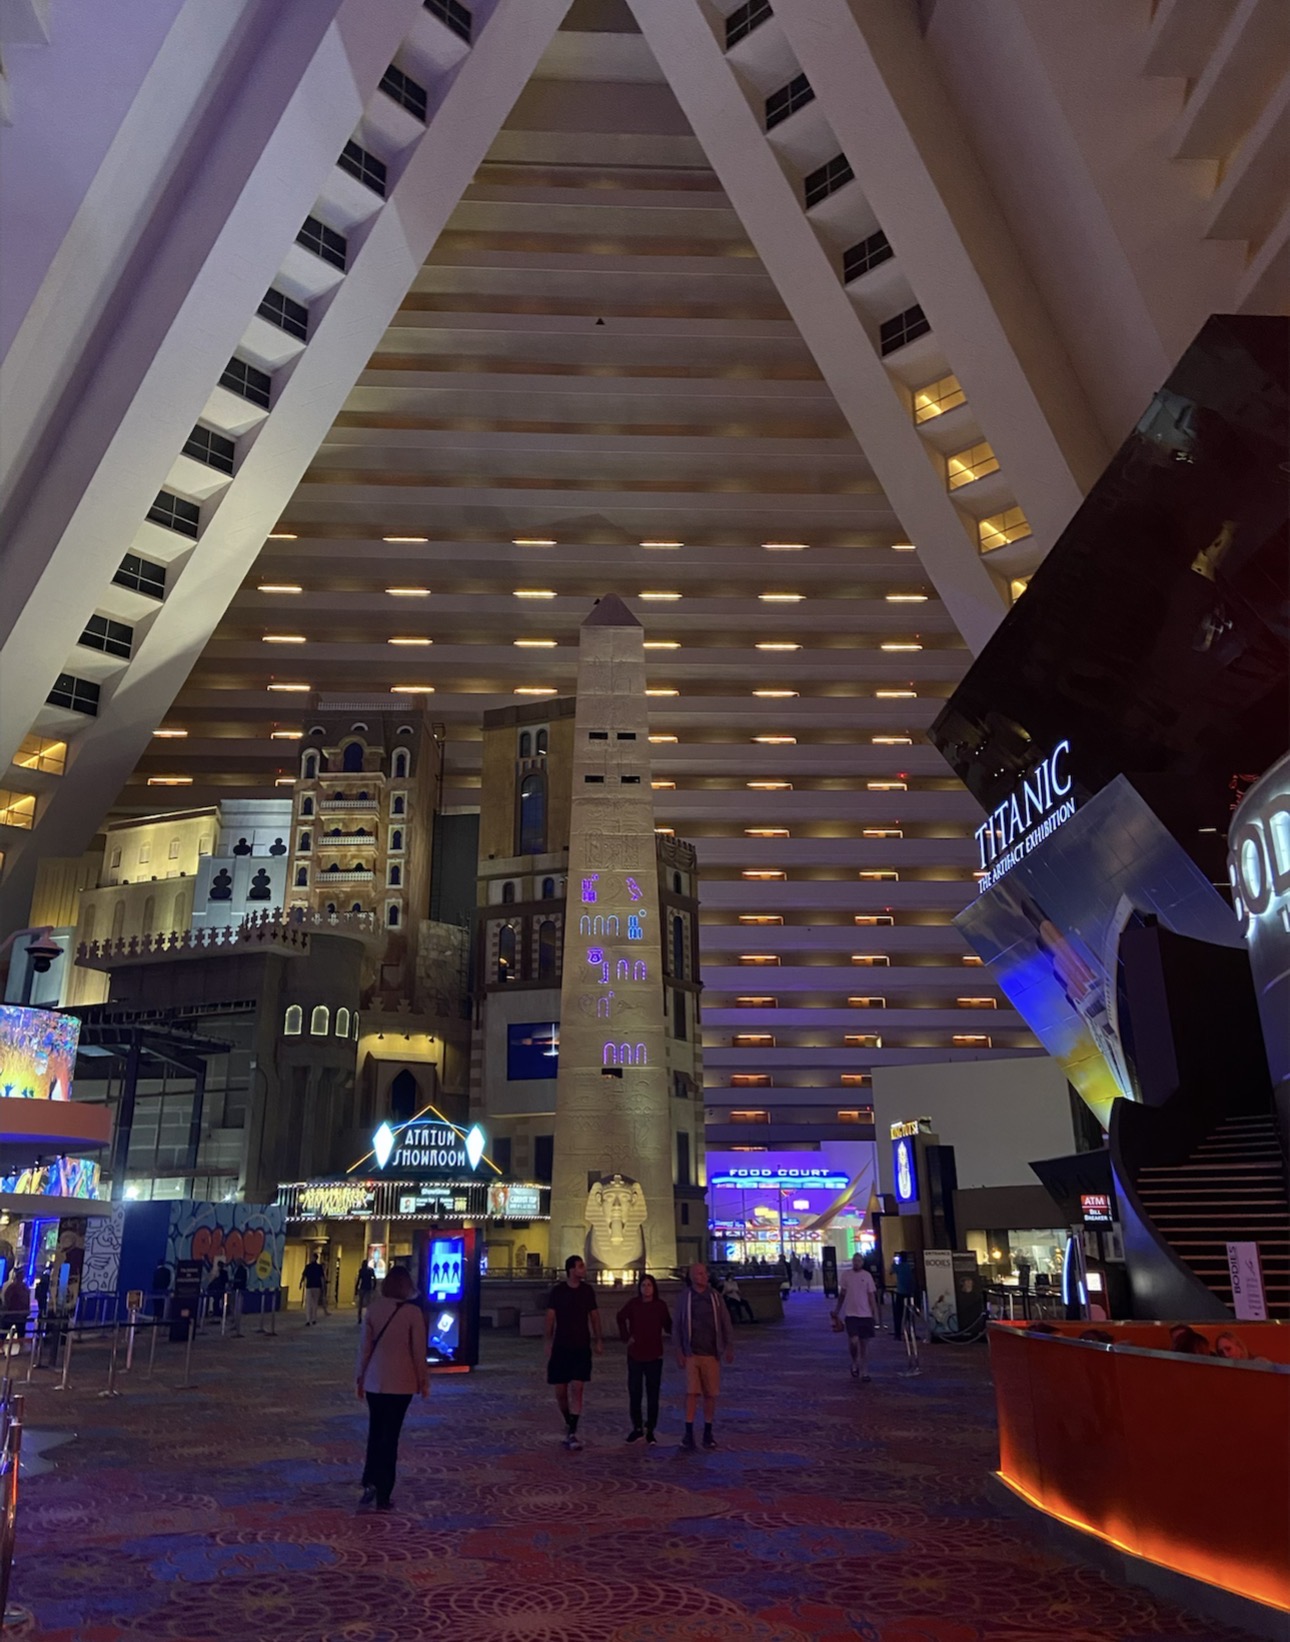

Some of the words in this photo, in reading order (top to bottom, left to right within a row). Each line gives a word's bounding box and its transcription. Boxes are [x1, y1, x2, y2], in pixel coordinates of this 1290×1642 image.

[974, 739, 1072, 870] TITANIC
[978, 873, 993, 893] THE
[992, 841, 1025, 883] ARTIFACT
[1025, 797, 1076, 854] EXHIBITION
[404, 1128, 456, 1146] ATRIUM
[392, 1148, 465, 1167] SHOWROOM
[729, 1169, 772, 1177] FOOD
[777, 1169, 830, 1177] COURT
[1084, 1196, 1105, 1206] ATM
[925, 1258, 951, 1267] BODIES
[1228, 1245, 1243, 1295] BODIES
